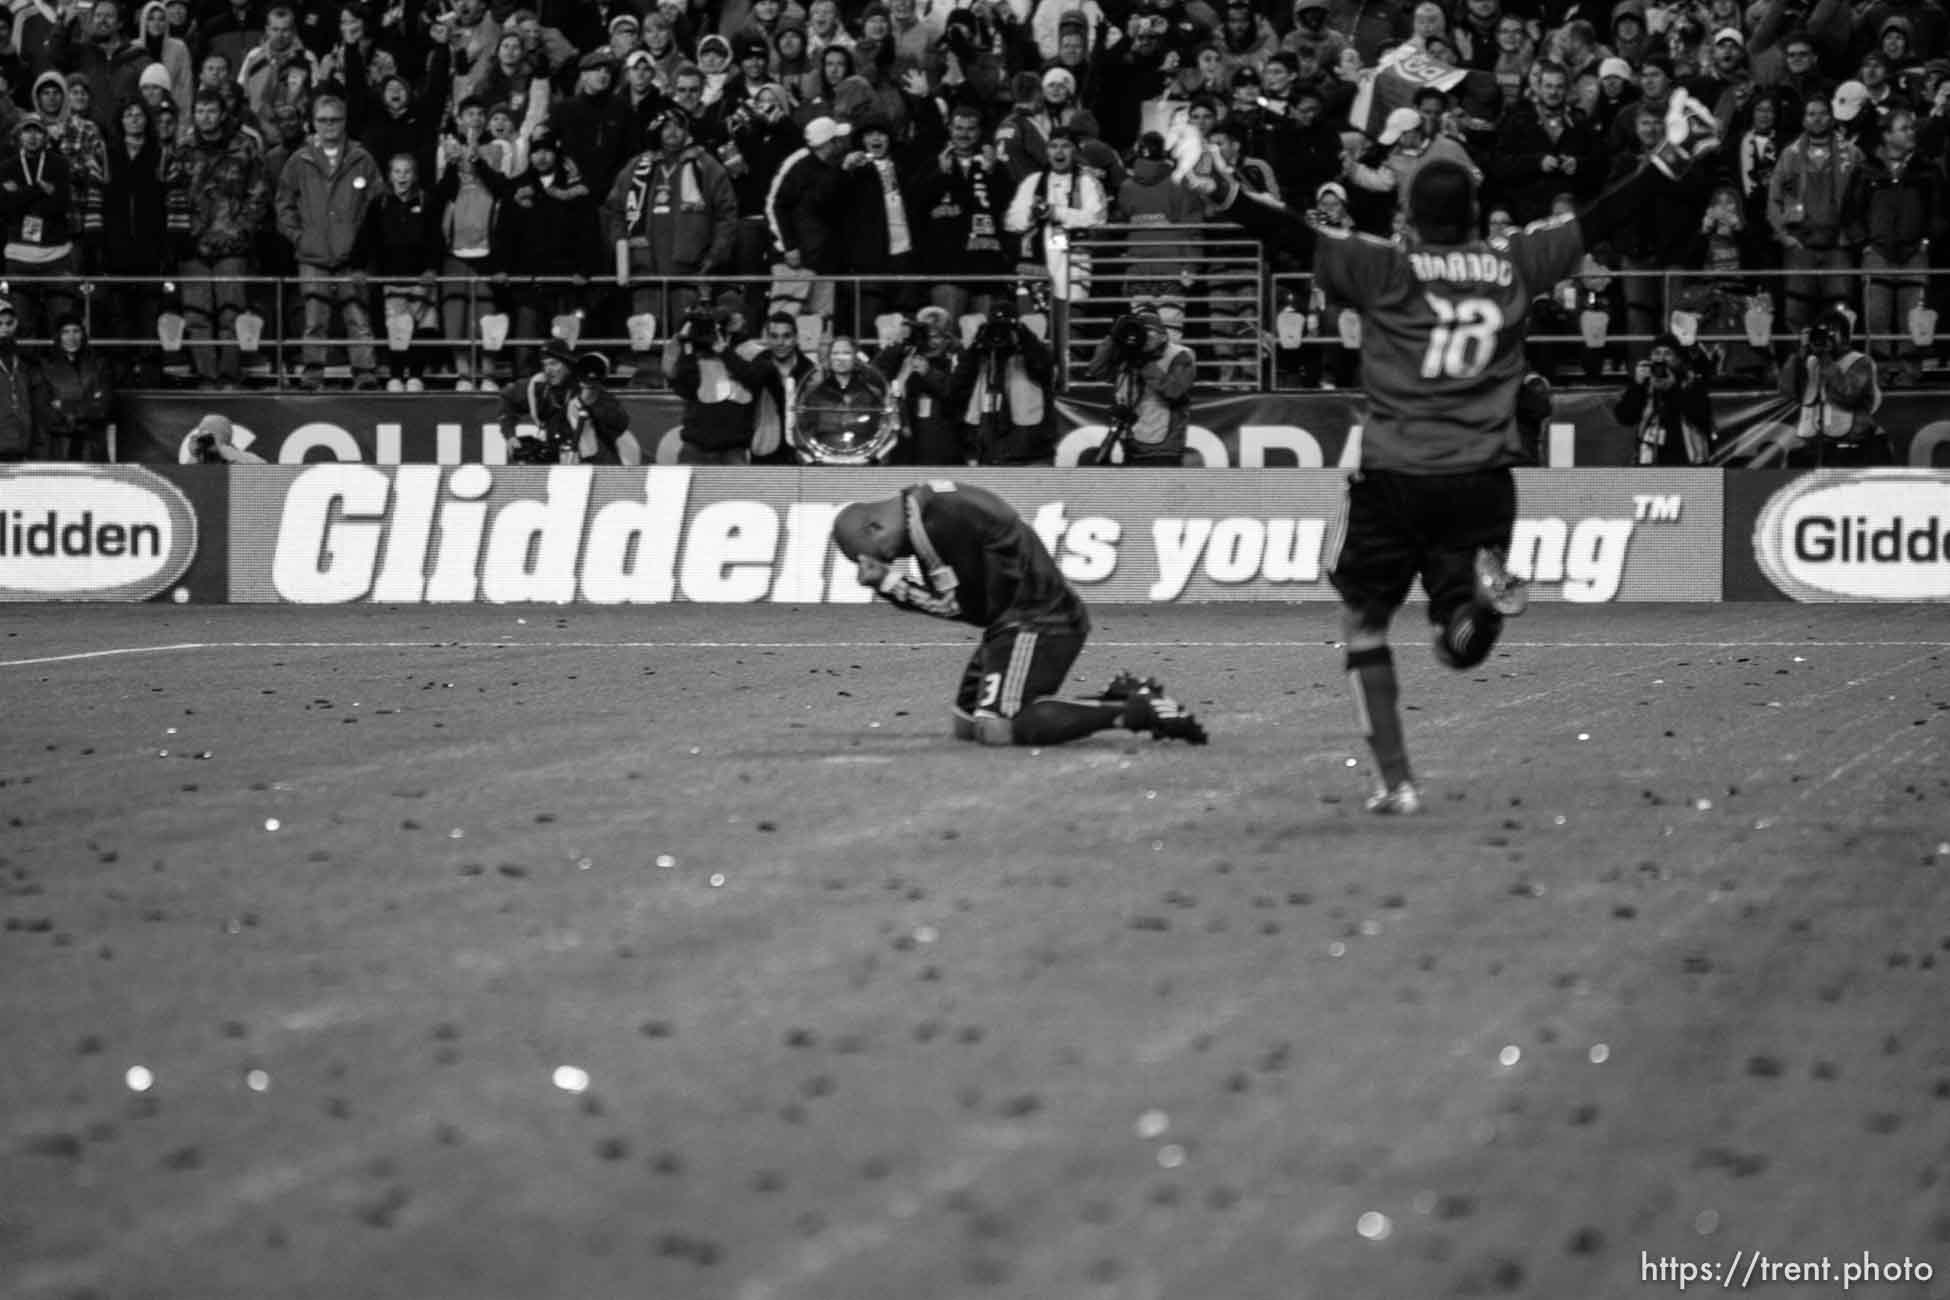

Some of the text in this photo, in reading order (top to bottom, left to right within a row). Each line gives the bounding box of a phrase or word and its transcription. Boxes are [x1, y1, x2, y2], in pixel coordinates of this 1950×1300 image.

[0, 509, 161, 557] lidden
[1794, 515, 1950, 563] Glidd
[1149, 517, 1328, 602] you
